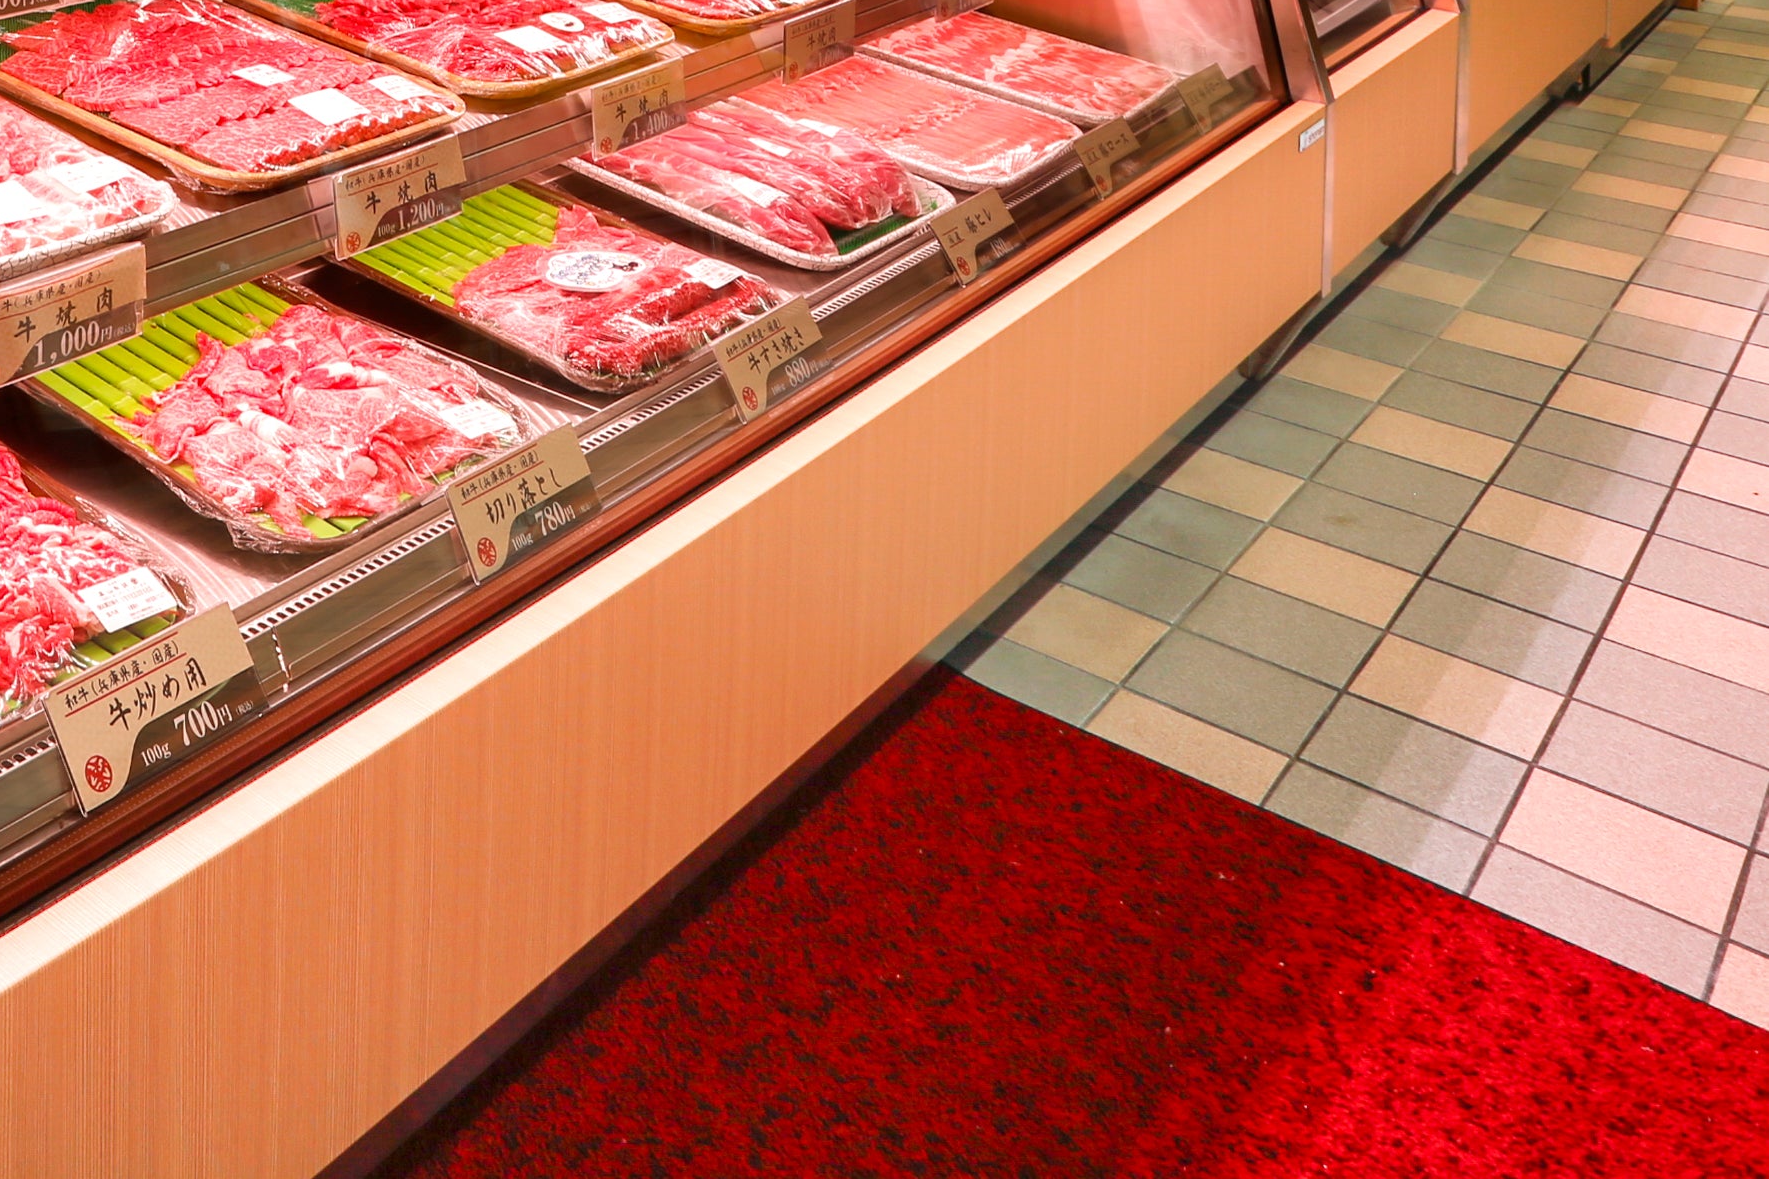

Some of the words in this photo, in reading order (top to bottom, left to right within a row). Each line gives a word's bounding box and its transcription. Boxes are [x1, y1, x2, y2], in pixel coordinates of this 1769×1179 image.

[365, 171, 439, 215] 牛焼肉
[14, 287, 113, 343] 牛焼肉
[33, 320, 113, 368] 1,000円
[747, 326, 805, 374] 牛すき焼き
[485, 468, 562, 524] 切り落とし
[511, 534, 534, 551] 100g
[534, 501, 576, 536] 780円
[109, 657, 207, 731] 牛炒め用
[140, 742, 171, 767] 100g
[173, 701, 233, 746] 700円
